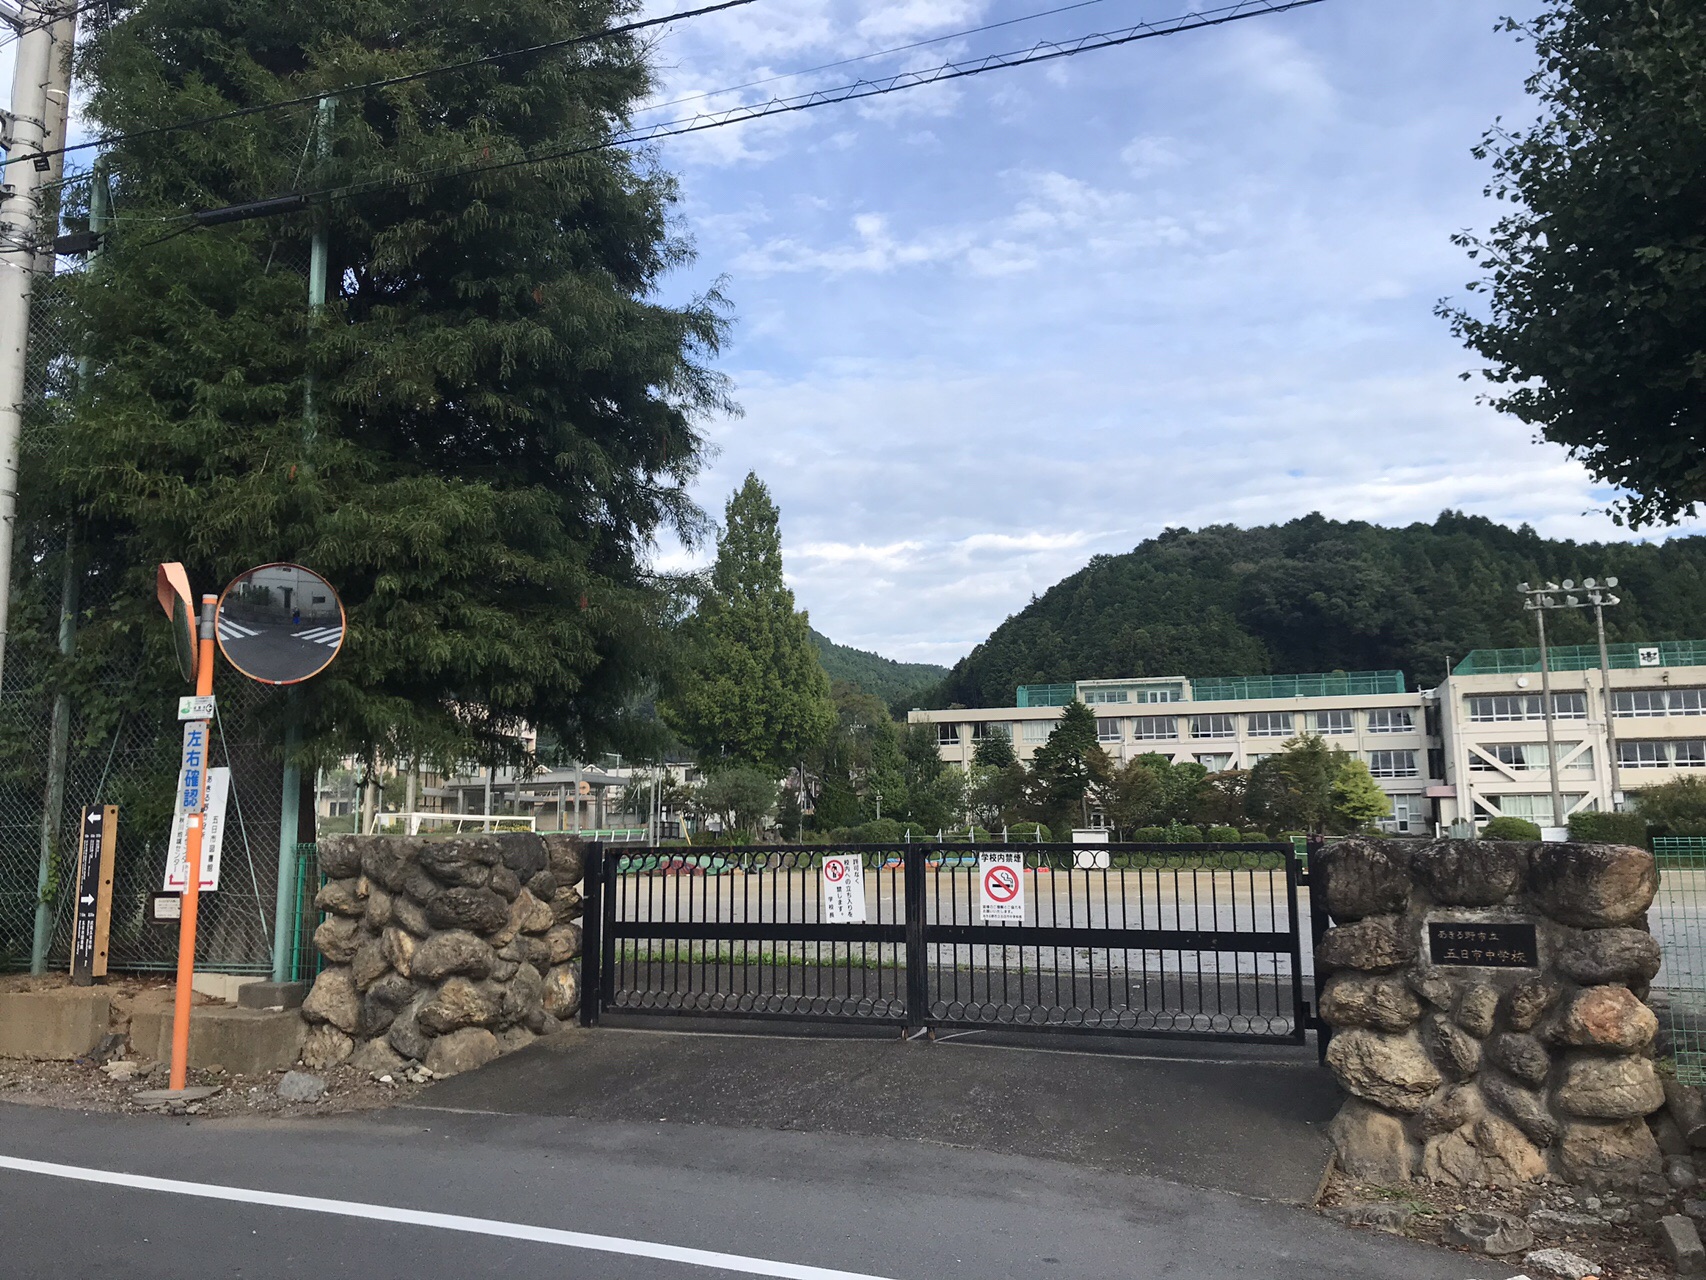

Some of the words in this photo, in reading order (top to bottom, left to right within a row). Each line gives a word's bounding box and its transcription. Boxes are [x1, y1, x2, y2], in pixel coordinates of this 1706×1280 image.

[183, 729, 202, 808] 左右確認
[981, 854, 1021, 863] 学校内禁煙
[844, 859, 853, 917] 校内への立ち入りを
[1438, 930, 1500, 942] あきる野市立
[1443, 948, 1528, 963] 五日市中学校
